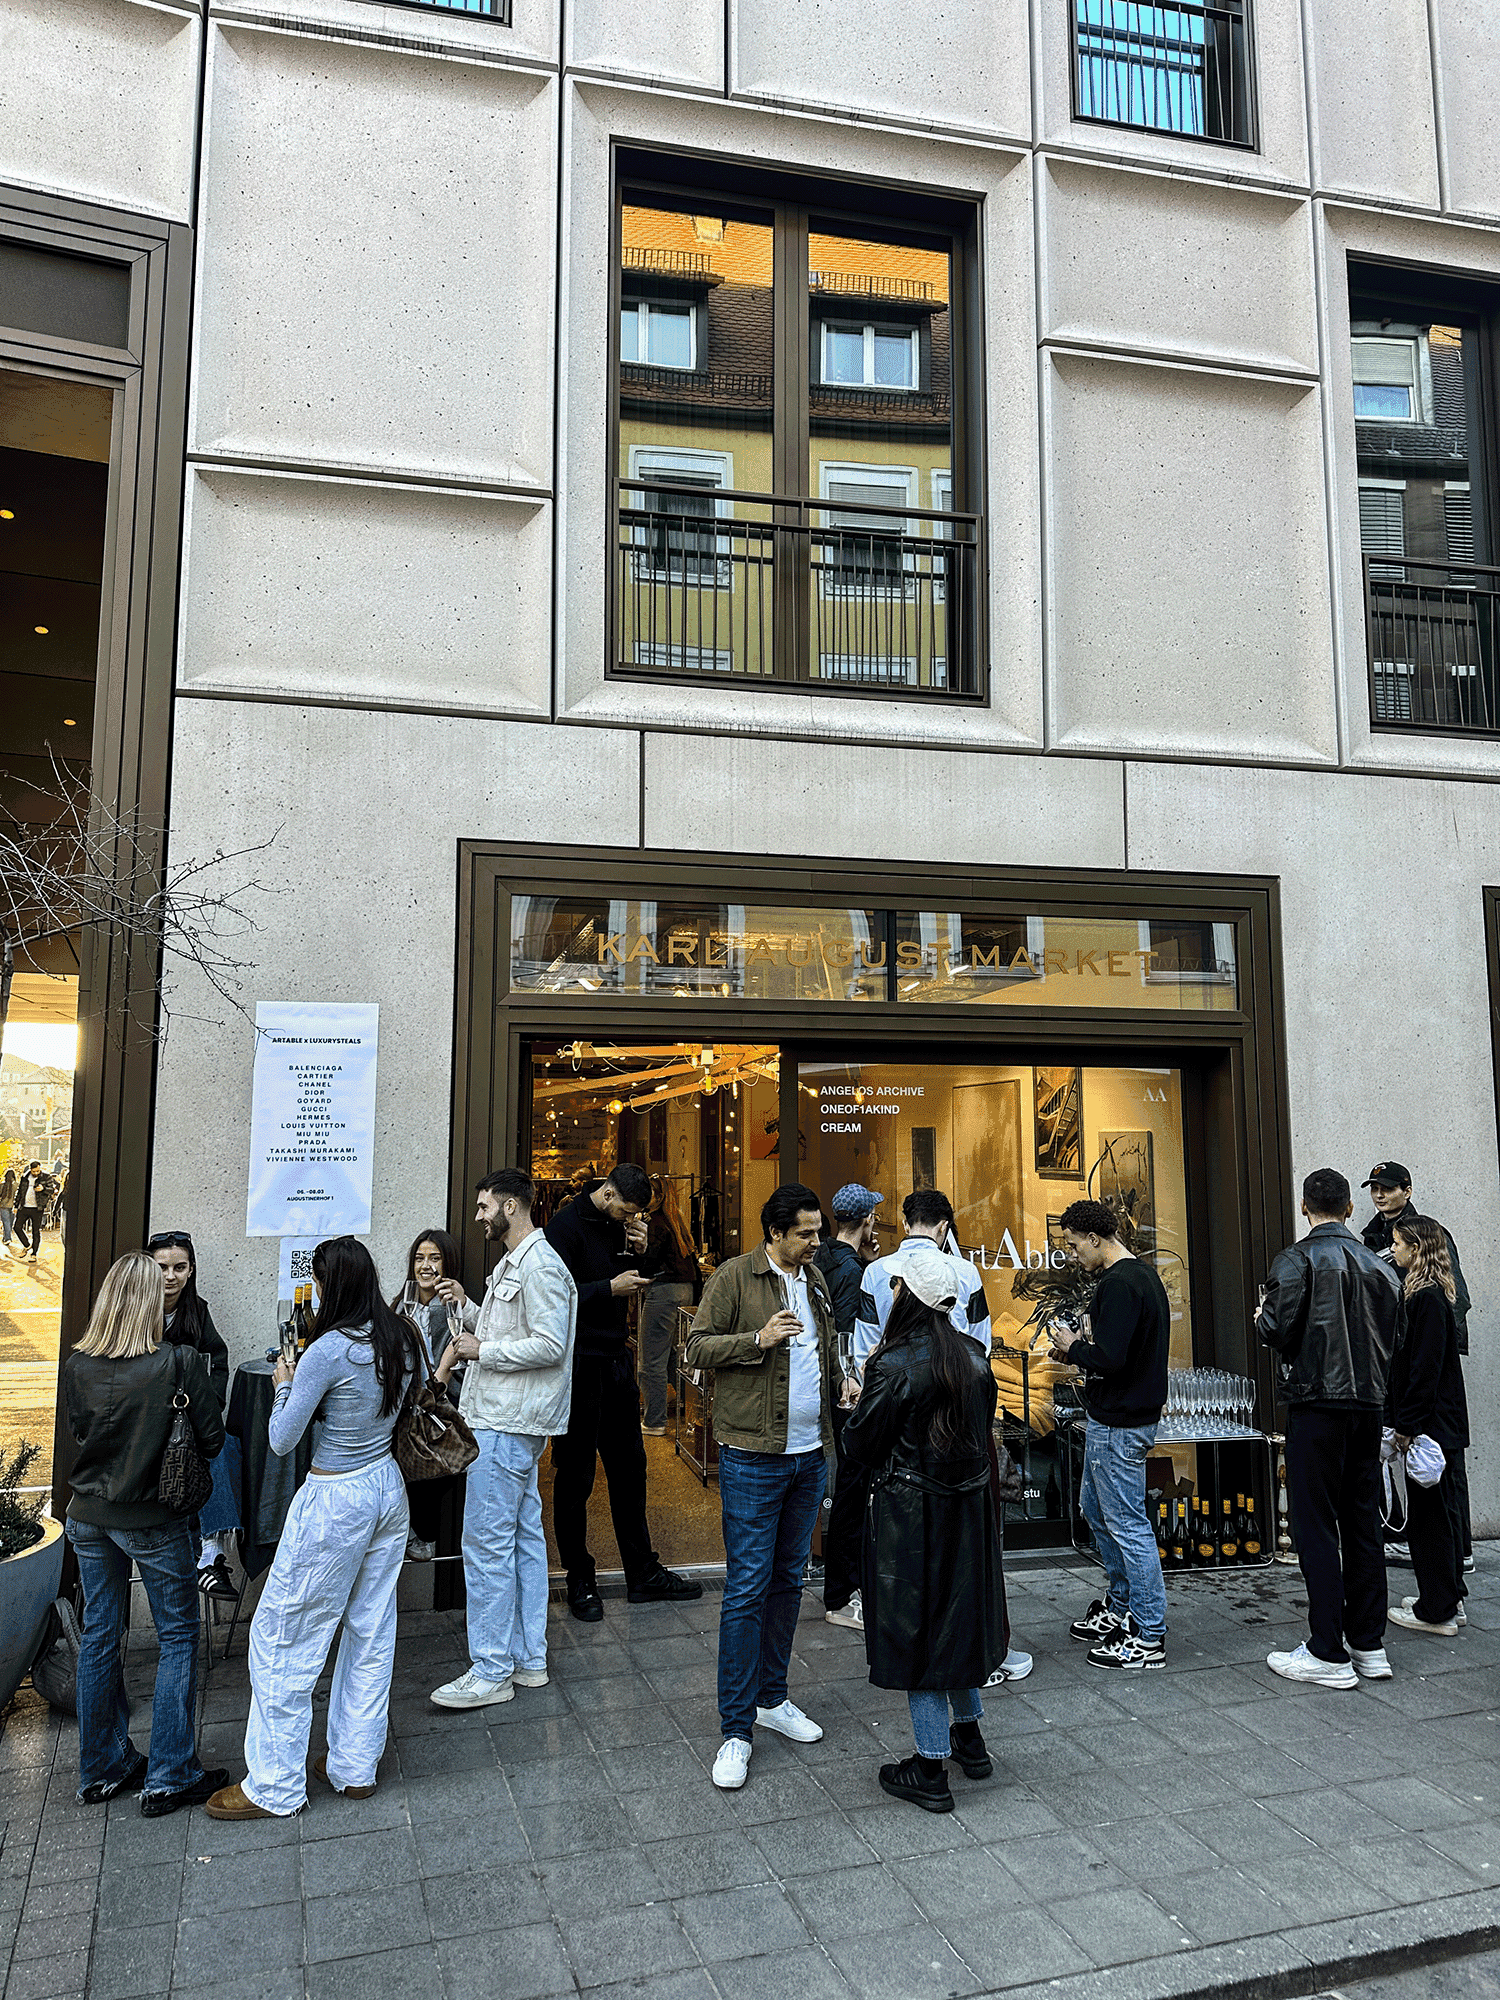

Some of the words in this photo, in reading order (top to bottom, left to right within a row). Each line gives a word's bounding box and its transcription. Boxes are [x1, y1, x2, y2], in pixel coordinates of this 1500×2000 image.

[598, 933, 727, 965] KARL
[746, 938, 951, 969] AUGUST
[971, 944, 1158, 977] MARKET
[309, 1037, 362, 1045] LUXURYSTEALS
[820, 1086, 874, 1096] ANGELOS
[876, 1087, 925, 1097] ARCHIVE
[1143, 1087, 1167, 1102] AA
[820, 1104, 900, 1115] ONEOF1AKIND
[820, 1123, 862, 1133] CREAM
